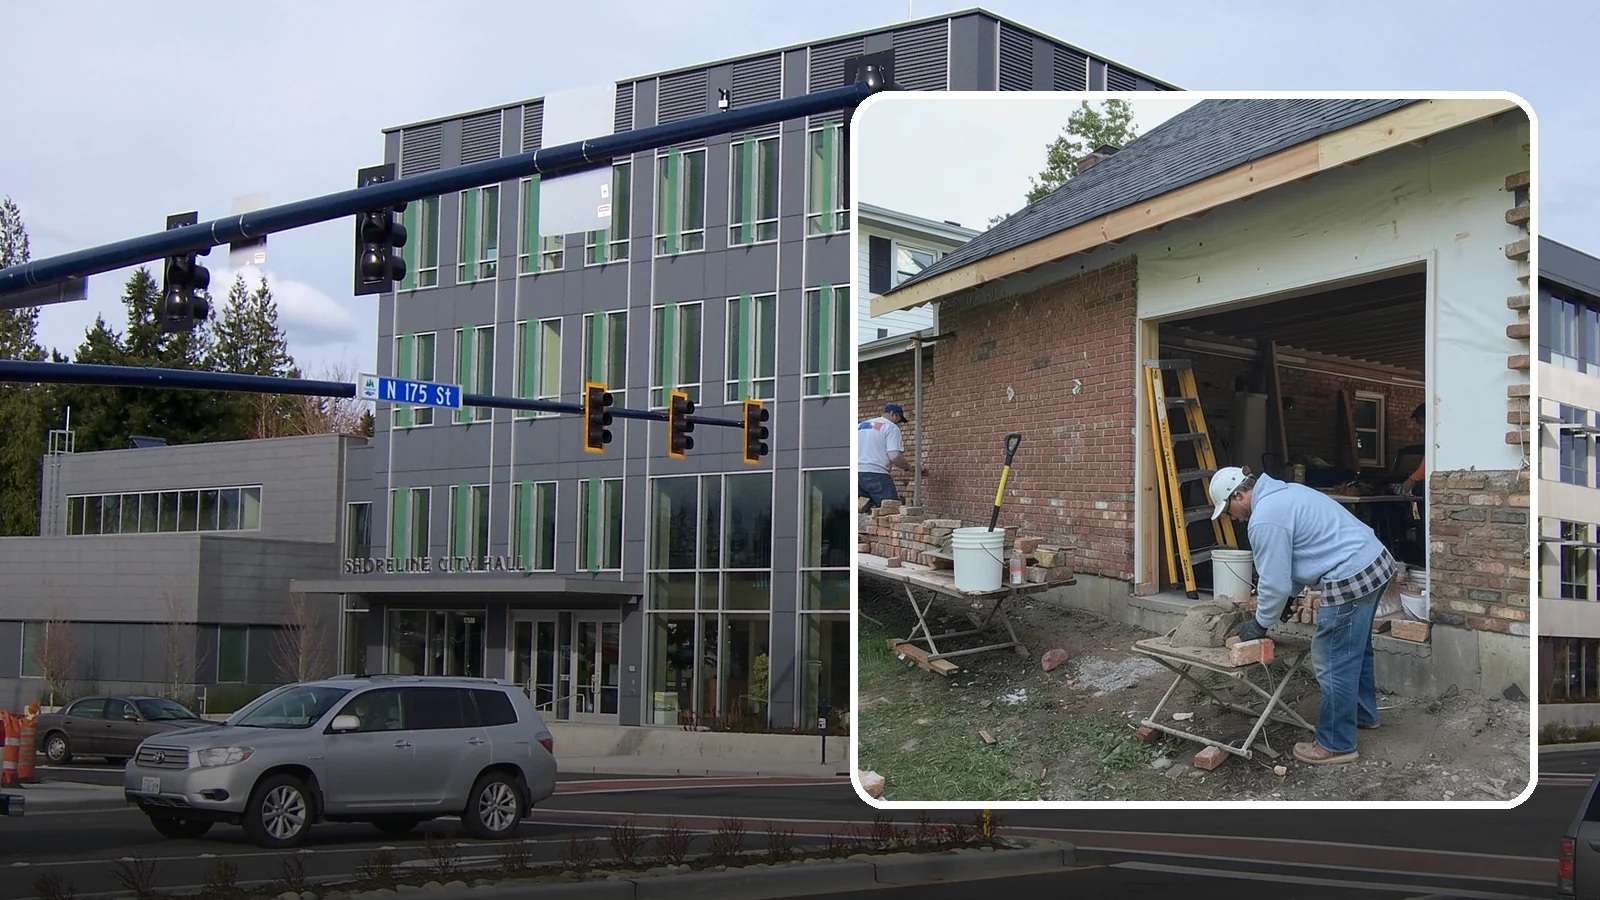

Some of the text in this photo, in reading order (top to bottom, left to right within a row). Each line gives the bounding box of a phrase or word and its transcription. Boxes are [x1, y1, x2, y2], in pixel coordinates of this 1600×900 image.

[387, 380, 451, 406] N 175 St
[344, 556, 525, 574] SHORELINE CITY HALL
